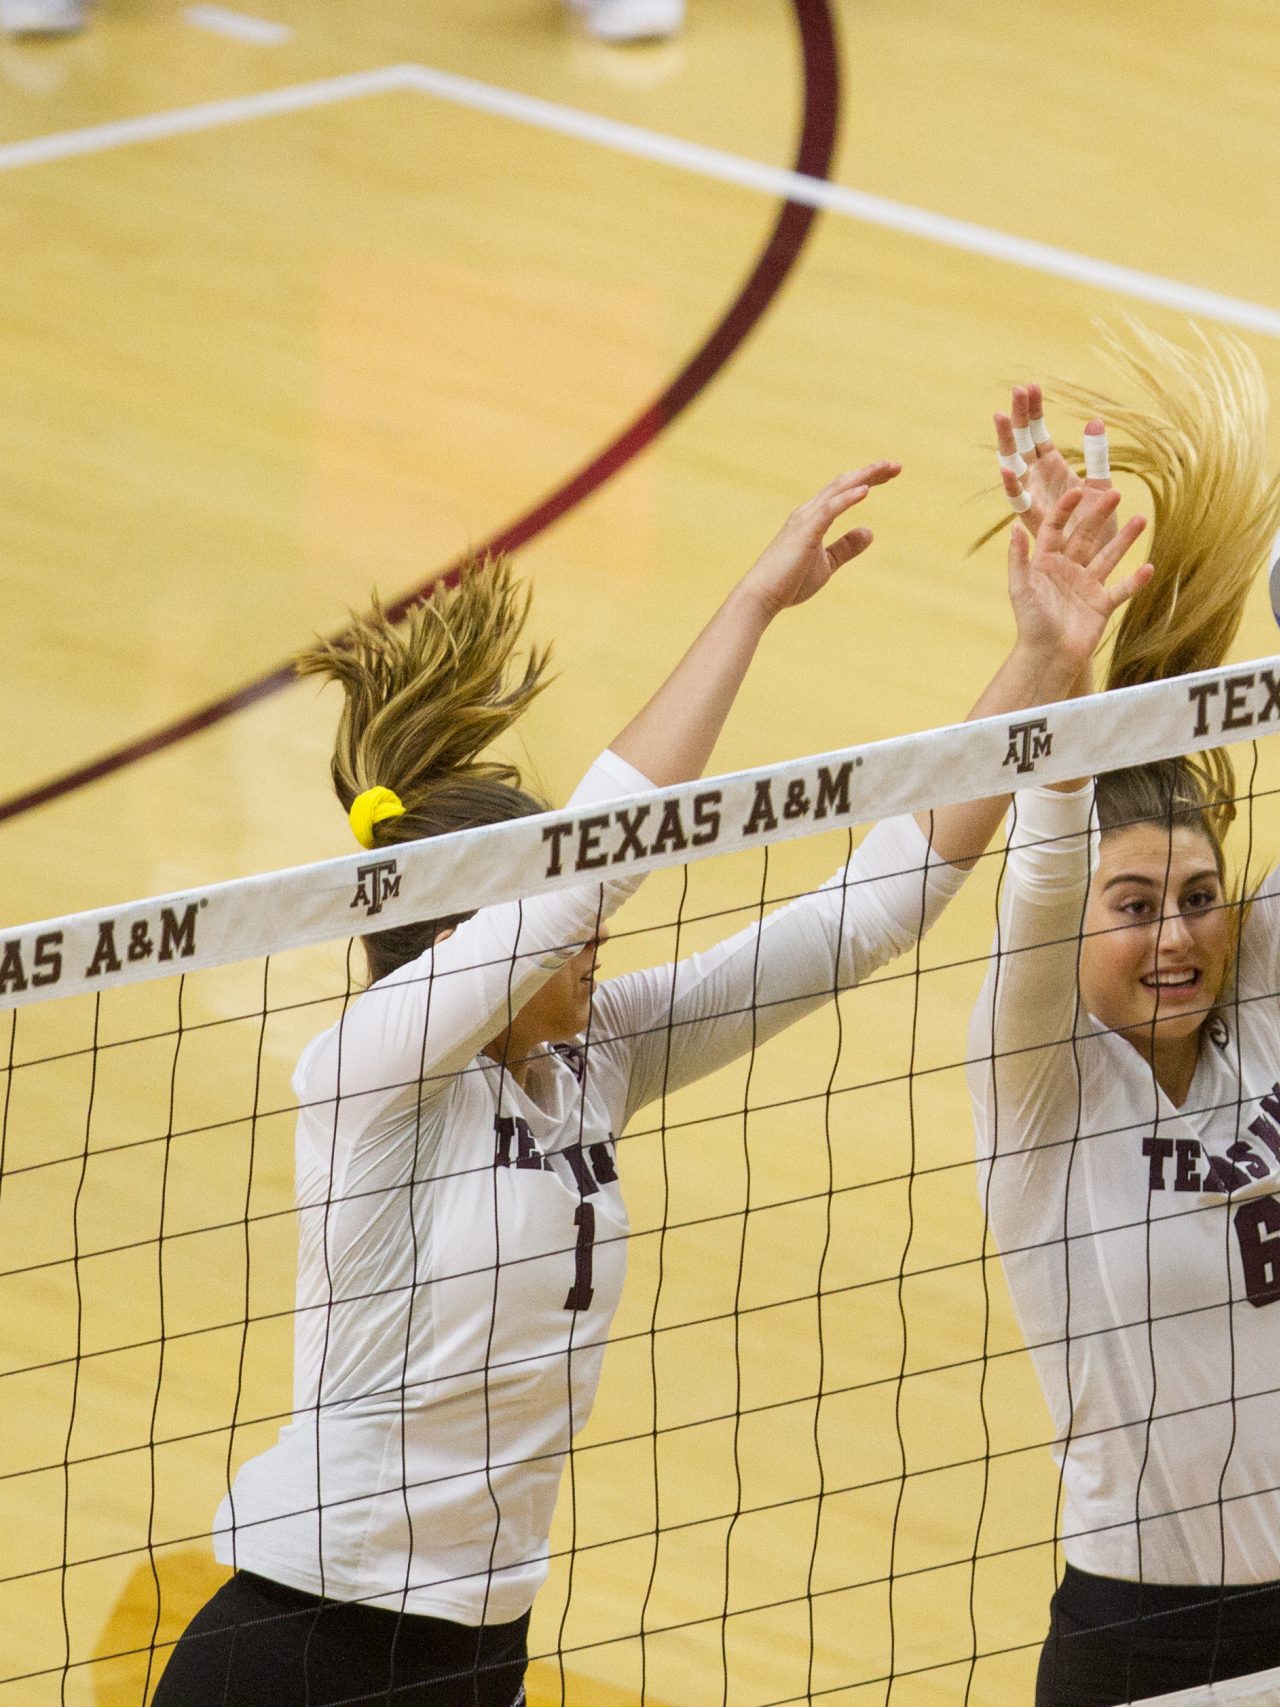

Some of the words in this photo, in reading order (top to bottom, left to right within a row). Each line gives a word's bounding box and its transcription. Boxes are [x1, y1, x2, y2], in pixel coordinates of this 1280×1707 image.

[541, 790, 722, 879] TEXAS
[743, 760, 854, 836] A&M
[85, 902, 199, 978] A&M
[563, 1202, 595, 1311] 1
